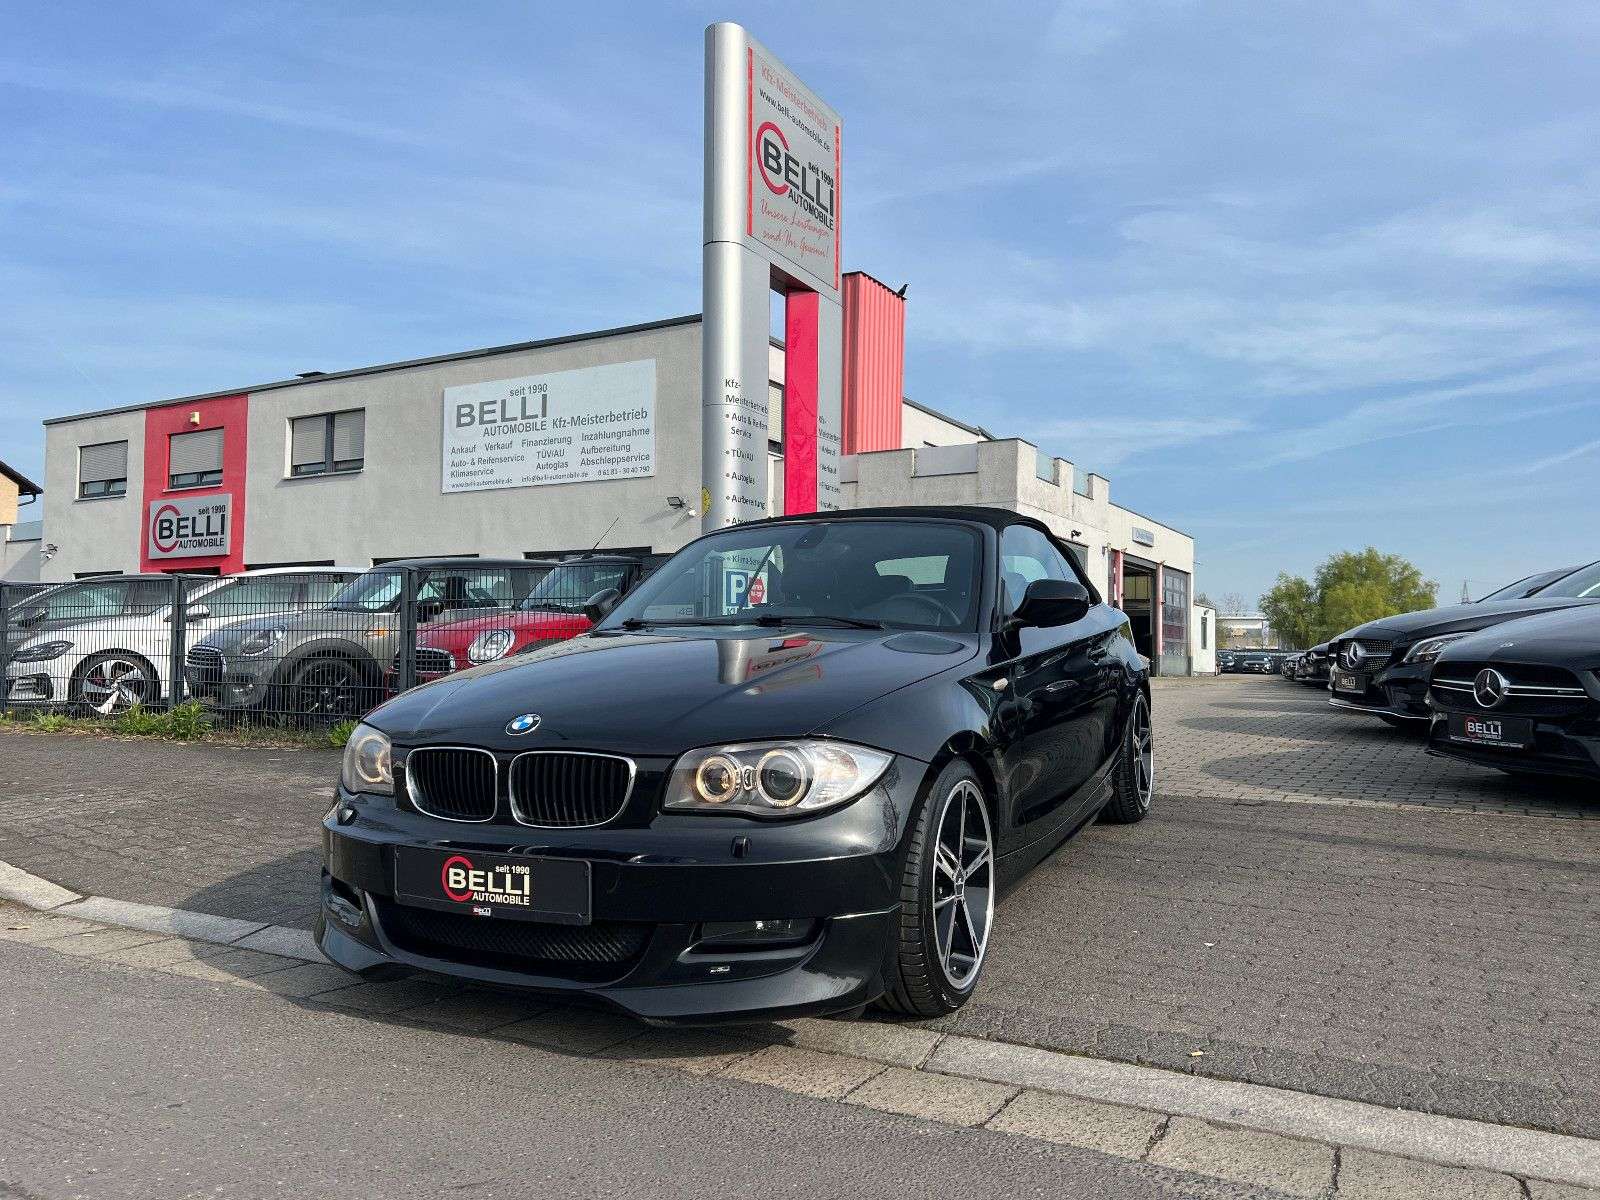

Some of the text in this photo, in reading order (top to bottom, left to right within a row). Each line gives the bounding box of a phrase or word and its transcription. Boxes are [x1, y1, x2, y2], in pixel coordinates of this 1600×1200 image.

[763, 137, 834, 217] BELLI
[787, 189, 834, 231] AUTOMOBILE
[509, 383, 548, 397] seit 1990
[725, 378, 741, 389] Kfz-
[456, 394, 547, 428] BELLI
[552, 408, 648, 429] Kfz-Meisterbetrieb
[483, 421, 547, 437] AUTOMOBILE
[730, 427, 752, 440] Service
[450, 428, 650, 455] Ankauf Verkauf Finanzierung Inzahlungnahme
[580, 444, 631, 456] Aufbereitung
[478, 454, 525, 466] Reifenservice
[536, 461, 569, 472] Autoglas
[580, 453, 650, 467] Abschleppservice
[450, 468, 494, 478] Klimaservice
[198, 504, 226, 515] seit 1990
[158, 514, 226, 540] BELLI
[178, 537, 225, 549] AUTOMOBILE
[731, 575, 746, 604] P
[1467, 722, 1502, 736] BELLI
[495, 865, 530, 875] seit 1990
[448, 868, 530, 896] BELLI
[472, 892, 530, 906] AUTOMOBILE
